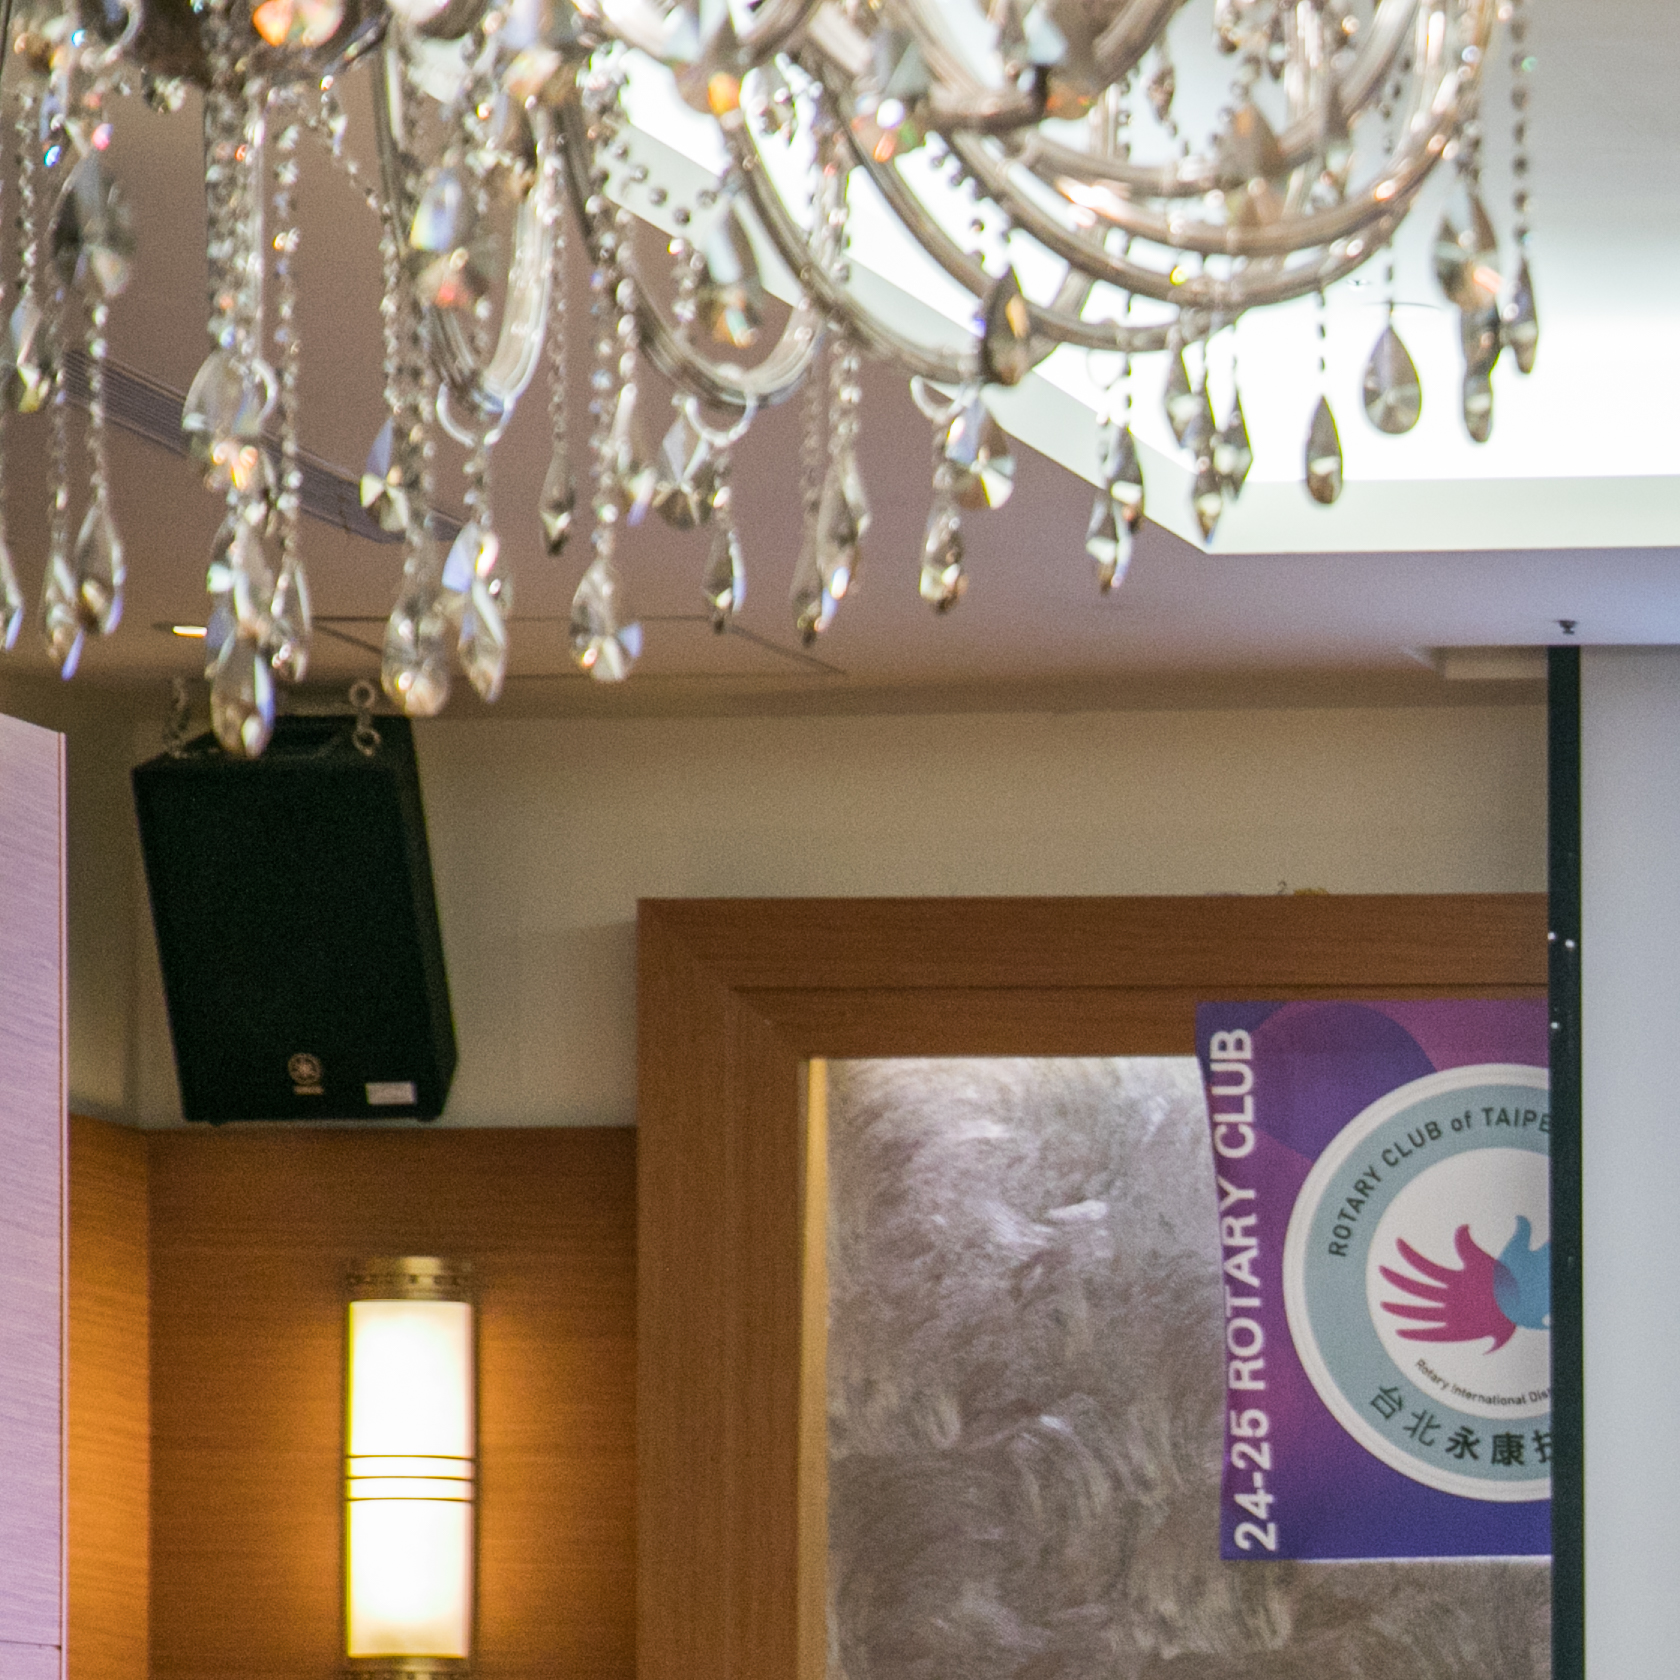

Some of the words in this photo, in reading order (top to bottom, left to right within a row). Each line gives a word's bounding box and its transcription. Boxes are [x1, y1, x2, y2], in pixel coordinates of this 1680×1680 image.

[1209, 1028, 1256, 1158] CLUB
[1328, 1166, 1383, 1257] ROTARY
[1381, 1121, 1442, 1168] CLUB
[1451, 1111, 1473, 1132] of
[1216, 1177, 1266, 1390] ROTARY
[1415, 1359, 1449, 1390] Rotary
[1451, 1384, 1526, 1406] International
[1230, 1408, 1277, 1551] 24-25
